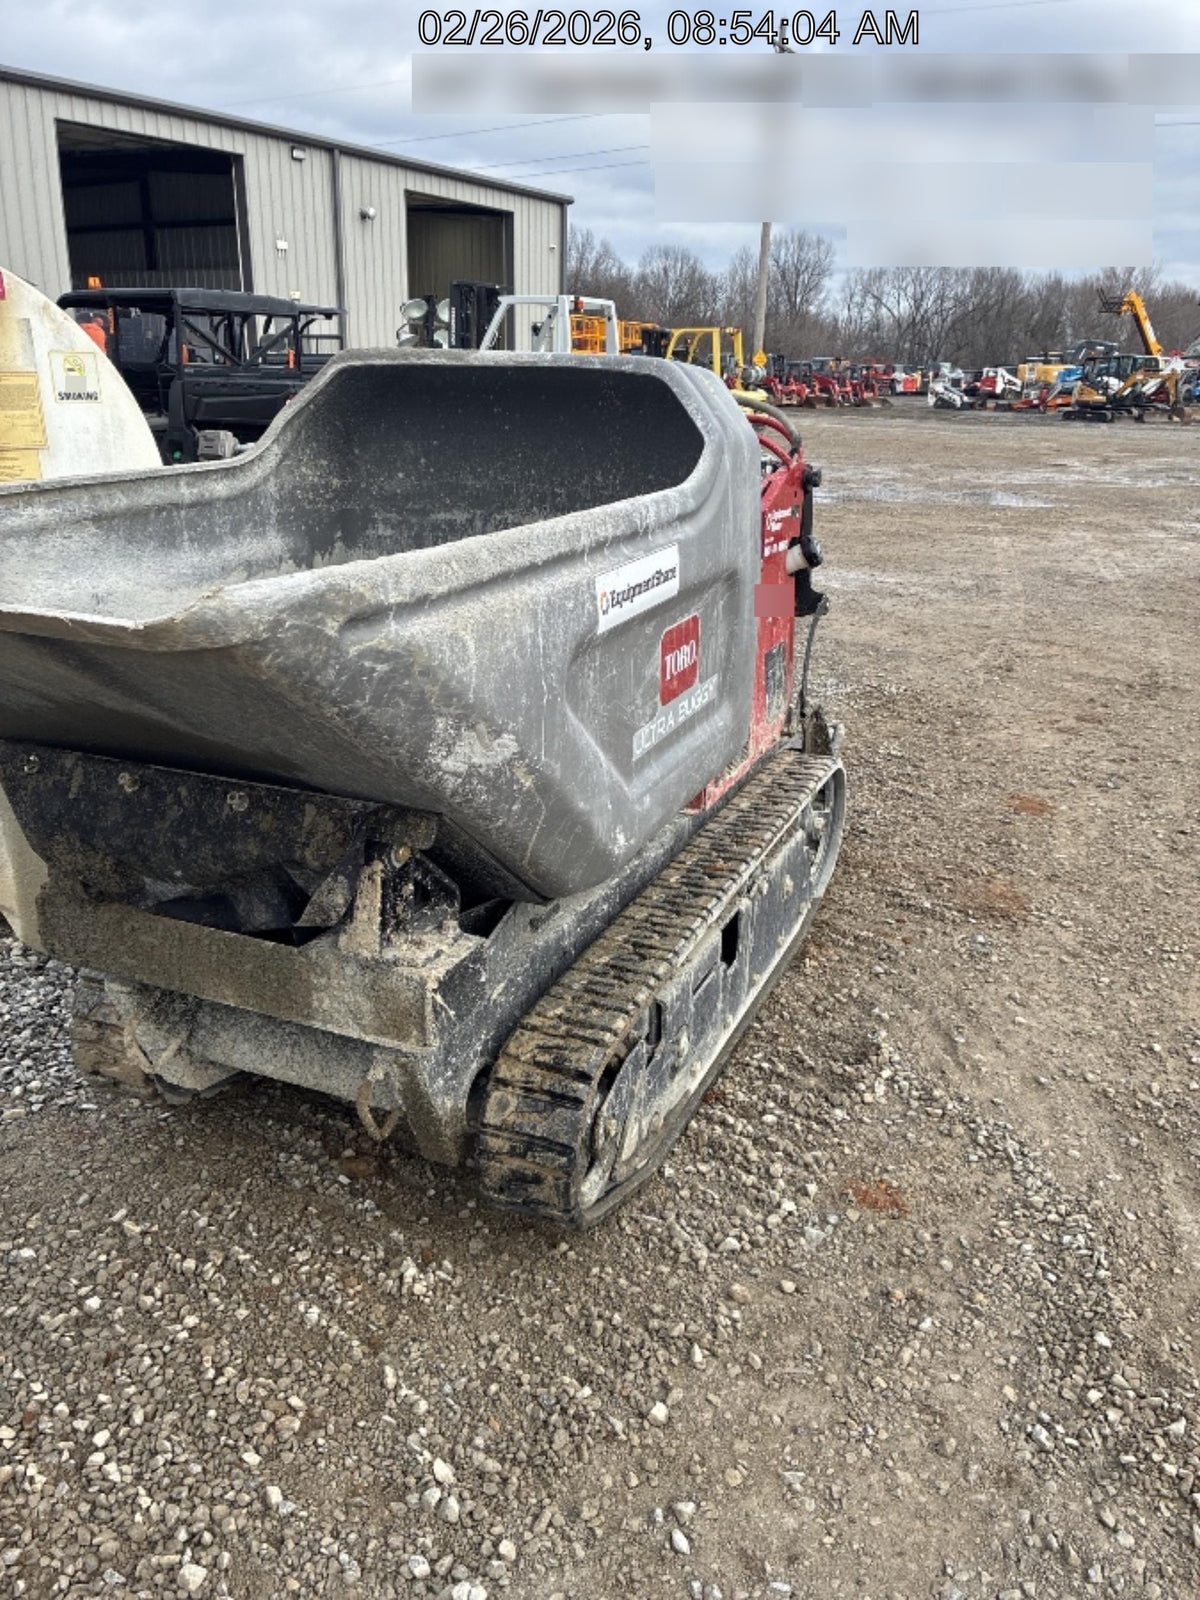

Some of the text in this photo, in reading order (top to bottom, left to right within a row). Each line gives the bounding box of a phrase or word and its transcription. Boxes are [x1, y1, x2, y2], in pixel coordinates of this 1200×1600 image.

[58, 391, 98, 401] SMOKING
[665, 639, 697, 681] TORO
[634, 676, 718, 755] ULTRA BUGGY
